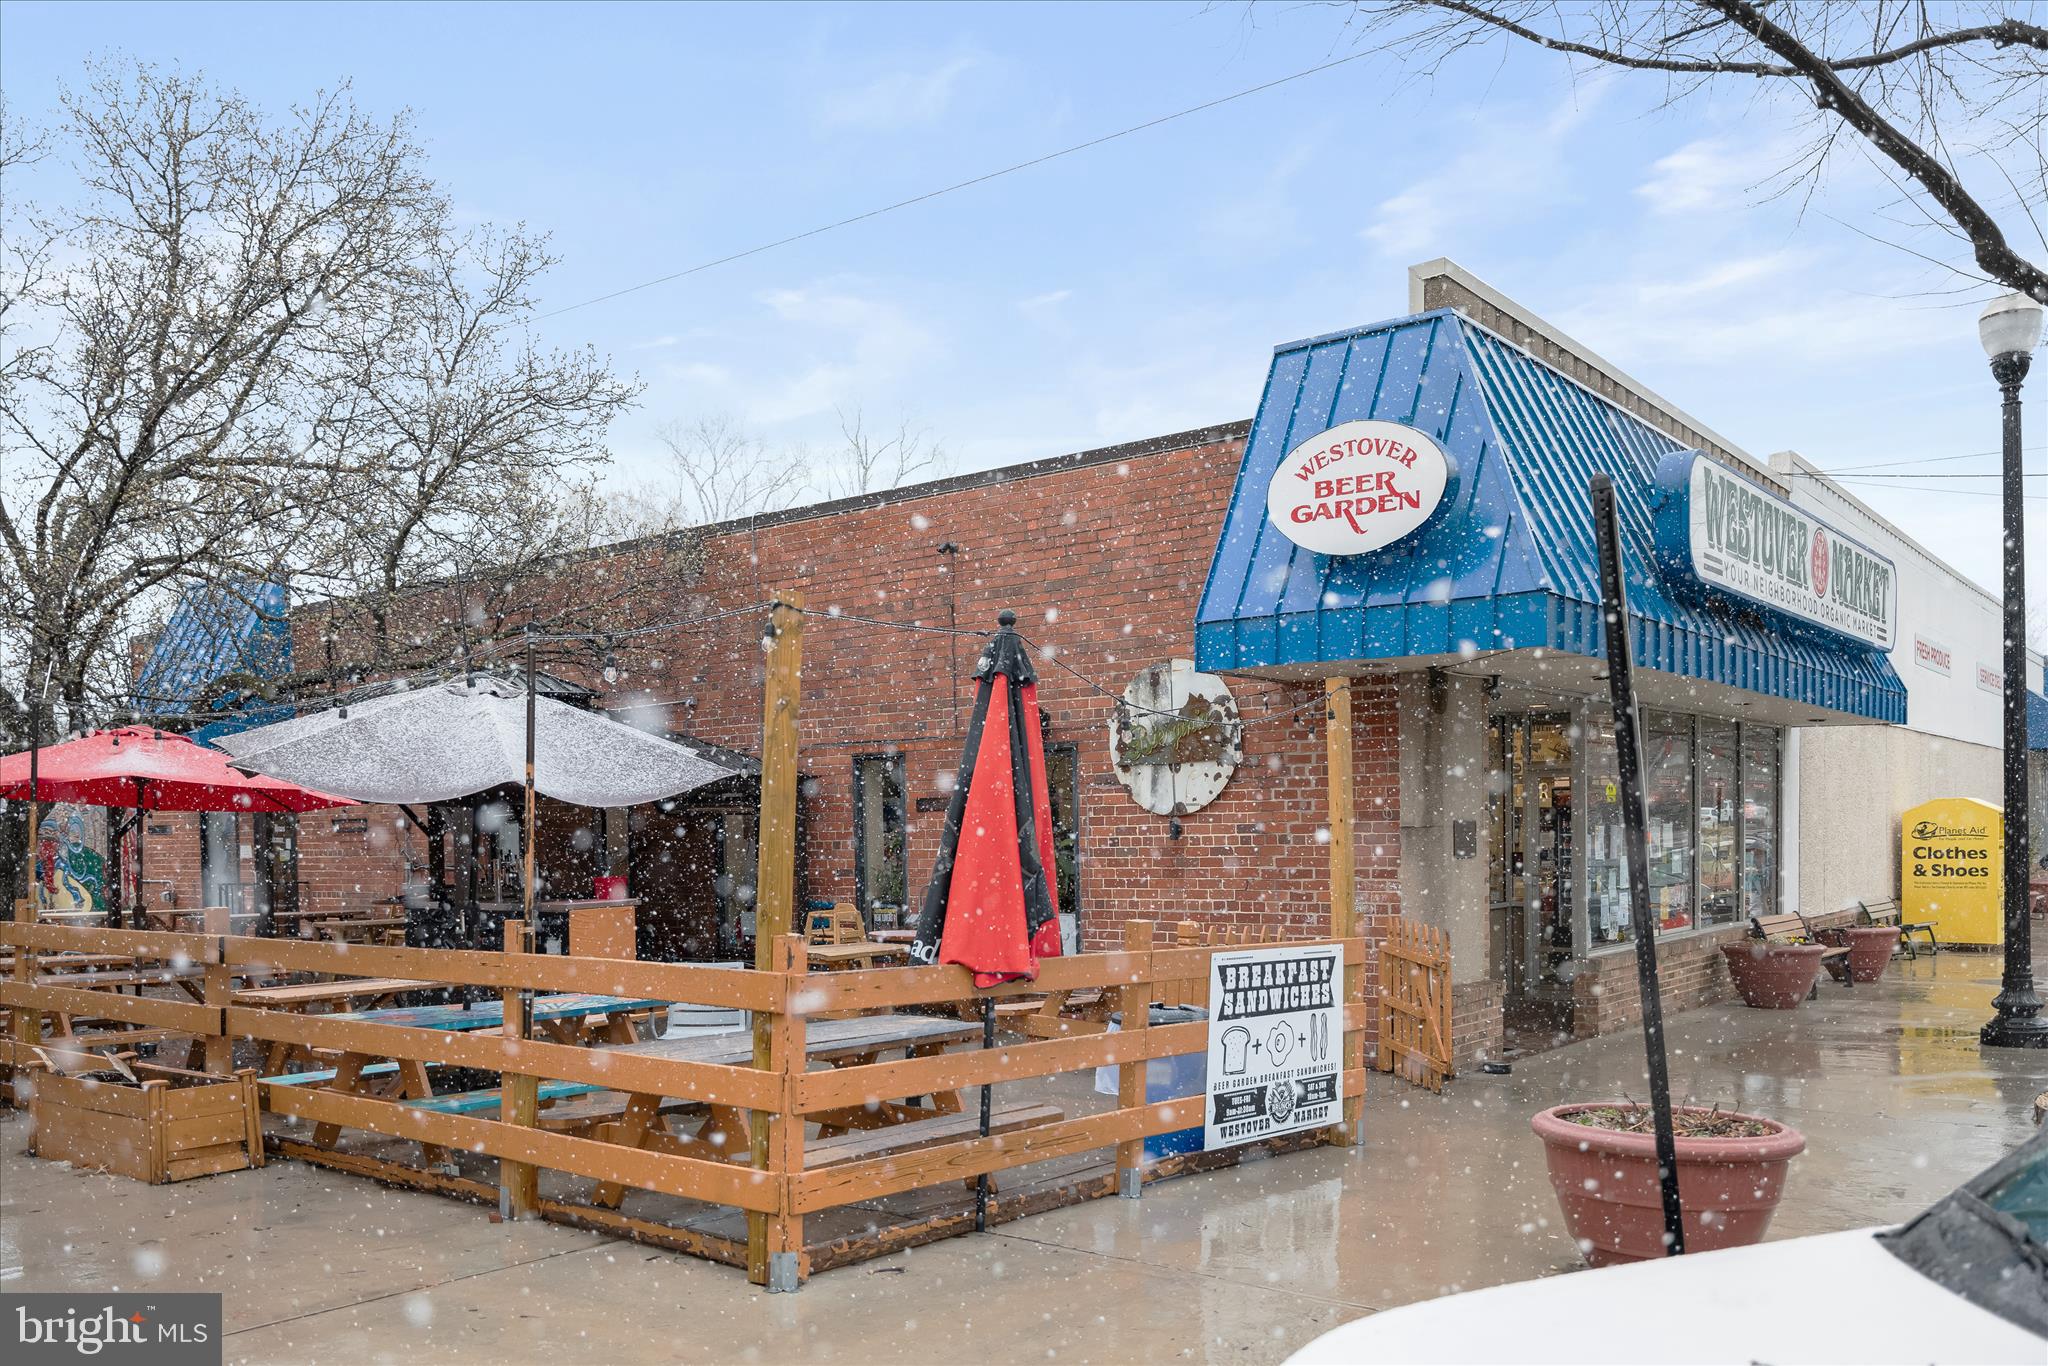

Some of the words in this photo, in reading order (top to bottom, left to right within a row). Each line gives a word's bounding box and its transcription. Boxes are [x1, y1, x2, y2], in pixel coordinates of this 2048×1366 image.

[1294, 438, 1418, 482] WESTOVER
[1314, 471, 1403, 499] BEER
[1290, 490, 1420, 535] GARDEN
[1703, 466, 1810, 591] WESTOVER
[1831, 540, 1890, 626] MARKET
[1723, 561, 1750, 589] YOUR
[1754, 575, 1818, 615] NEIGHBORHOOD
[1820, 602, 1850, 629] ORGANIC
[1852, 614, 1878, 638] MARKET
[1916, 639, 1931, 661] FRESH
[1931, 647, 1951, 670] PRODUCE
[1938, 826, 1967, 835] Planet
[1969, 826, 1986, 834] Aid
[1912, 846, 1988, 859] Clothes
[1913, 864, 1927, 877] &
[1931, 864, 1989, 877] Shoes
[1225, 959, 1330, 990] BREAKFAST
[1223, 982, 1331, 1016] SANDWICHES
[1213, 1081, 1229, 1092] BEER
[1233, 1077, 1257, 1088] GARDEN
[1260, 1069, 1294, 1083] BREAKFAST
[1297, 1062, 1337, 1076] SANDWICHES!
[1220, 1117, 1271, 1140] WESTOVER
[1293, 1105, 1329, 1124] MARKET
